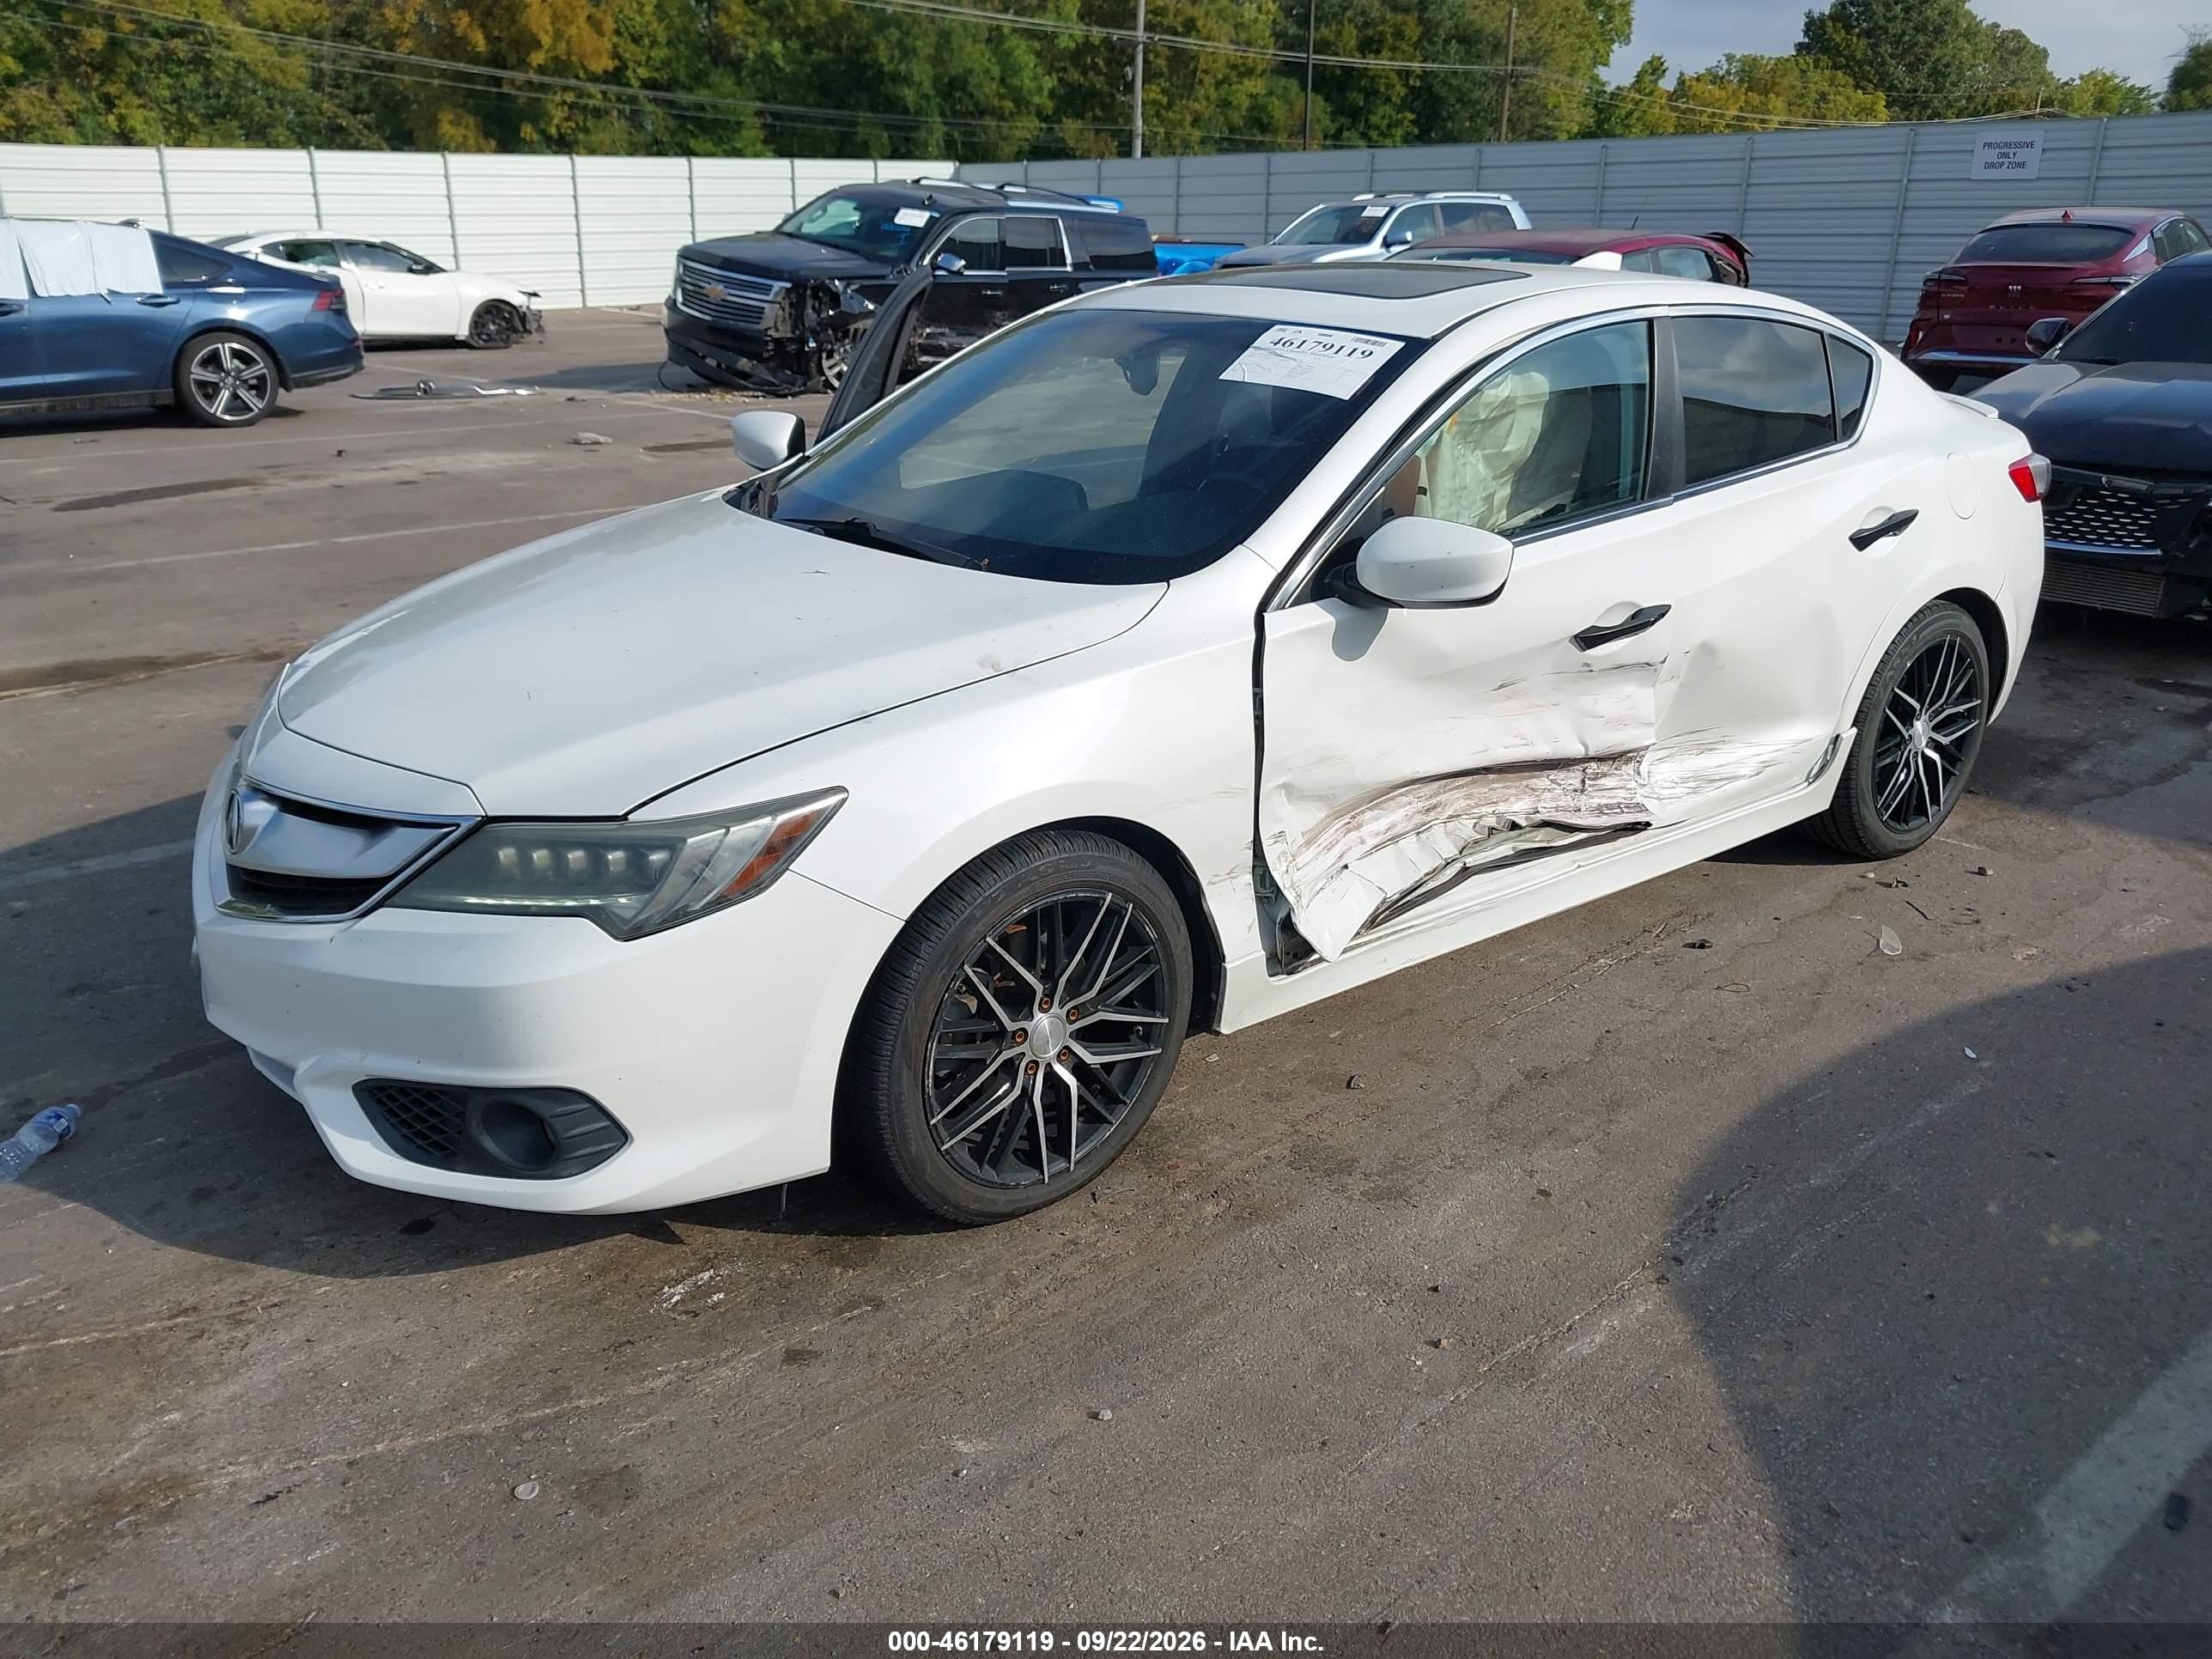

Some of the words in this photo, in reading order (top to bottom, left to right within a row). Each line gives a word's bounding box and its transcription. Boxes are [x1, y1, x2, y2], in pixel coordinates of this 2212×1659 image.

[1983, 141, 2035, 150] PROGRESSIVE
[1997, 151, 2017, 160] ONLY
[1984, 161, 2005, 170] DROP
[2006, 161, 2027, 169] ZONE
[1269, 337, 1374, 359] 46179119
